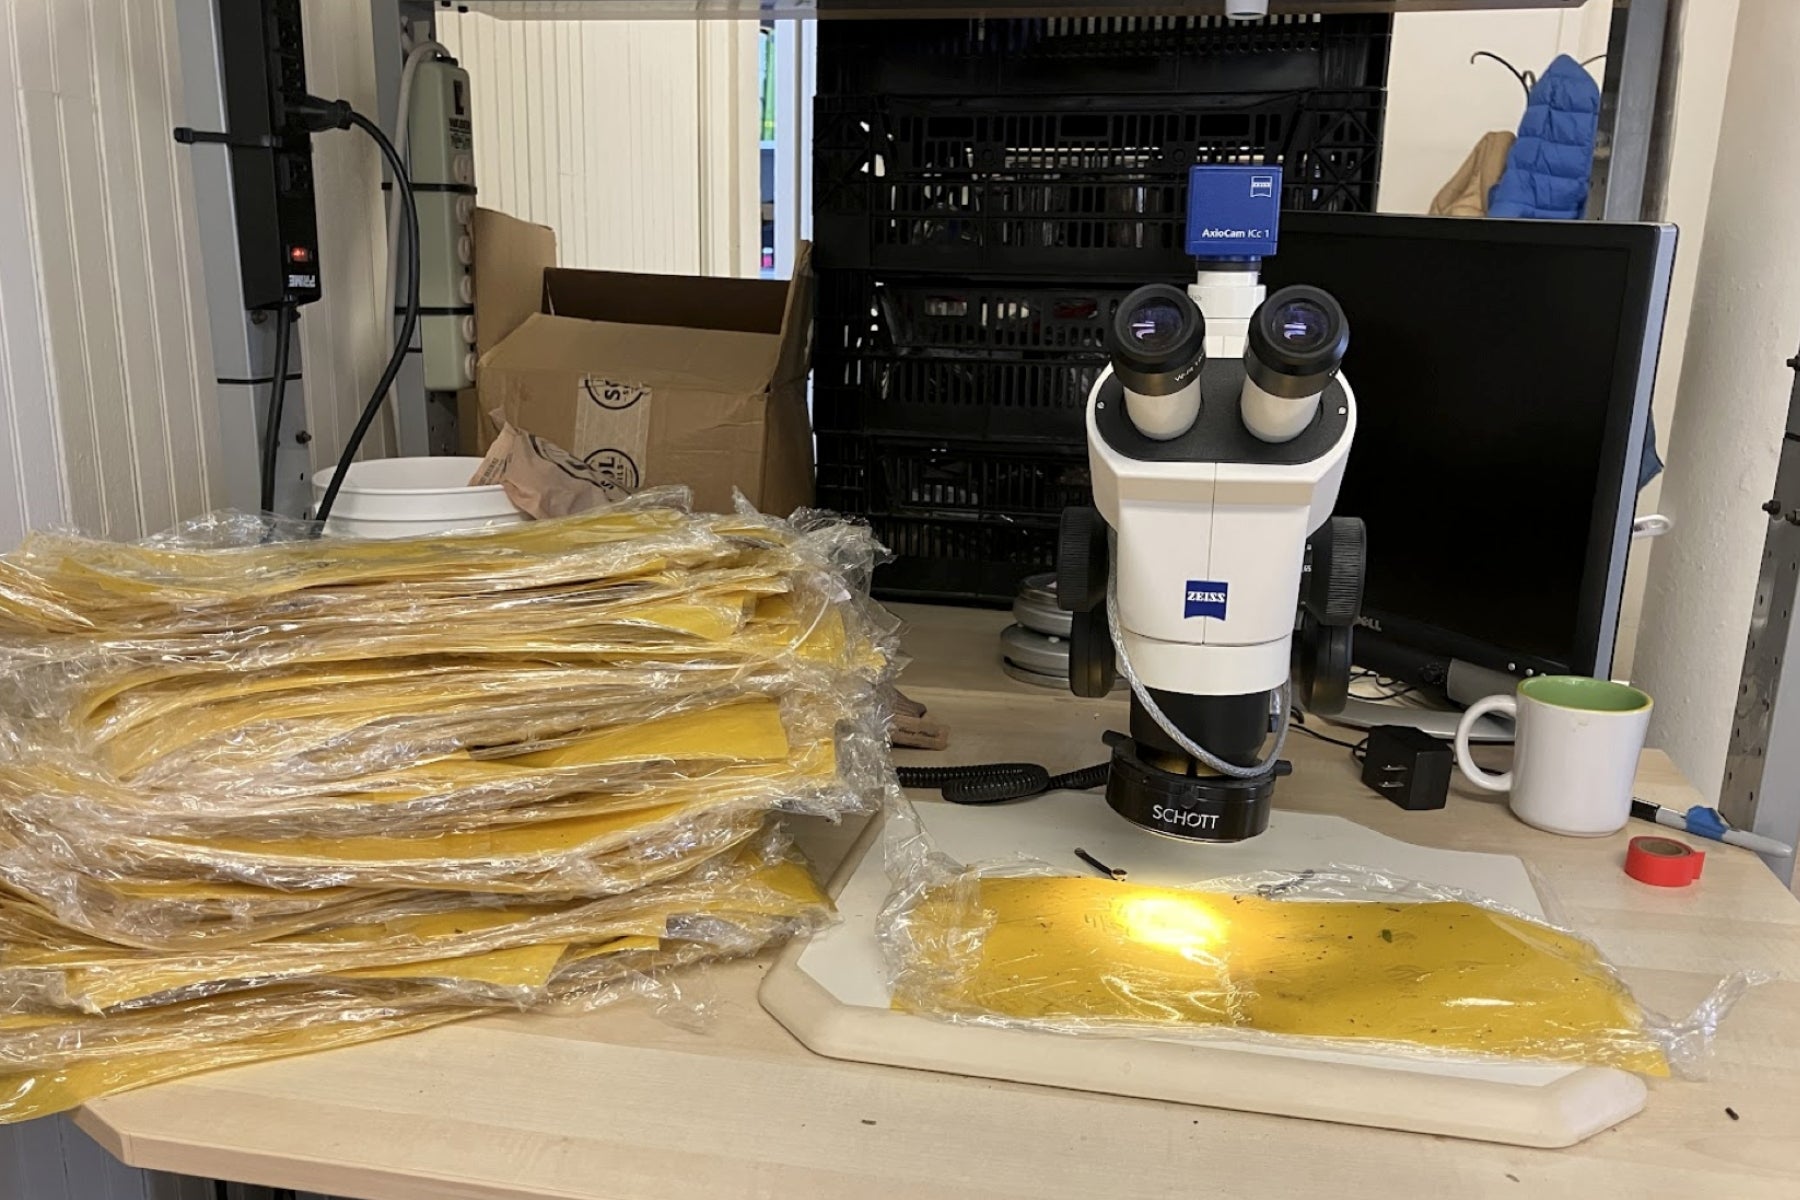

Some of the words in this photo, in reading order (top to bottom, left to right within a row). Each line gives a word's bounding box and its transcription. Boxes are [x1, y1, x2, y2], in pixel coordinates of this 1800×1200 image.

[1202, 228, 1246, 238] AxioCam
[1264, 229, 1270, 238] 1
[1187, 591, 1226, 603] ZEISS
[1357, 616, 1382, 632] ELL
[1152, 804, 1220, 830] SCHOTT
